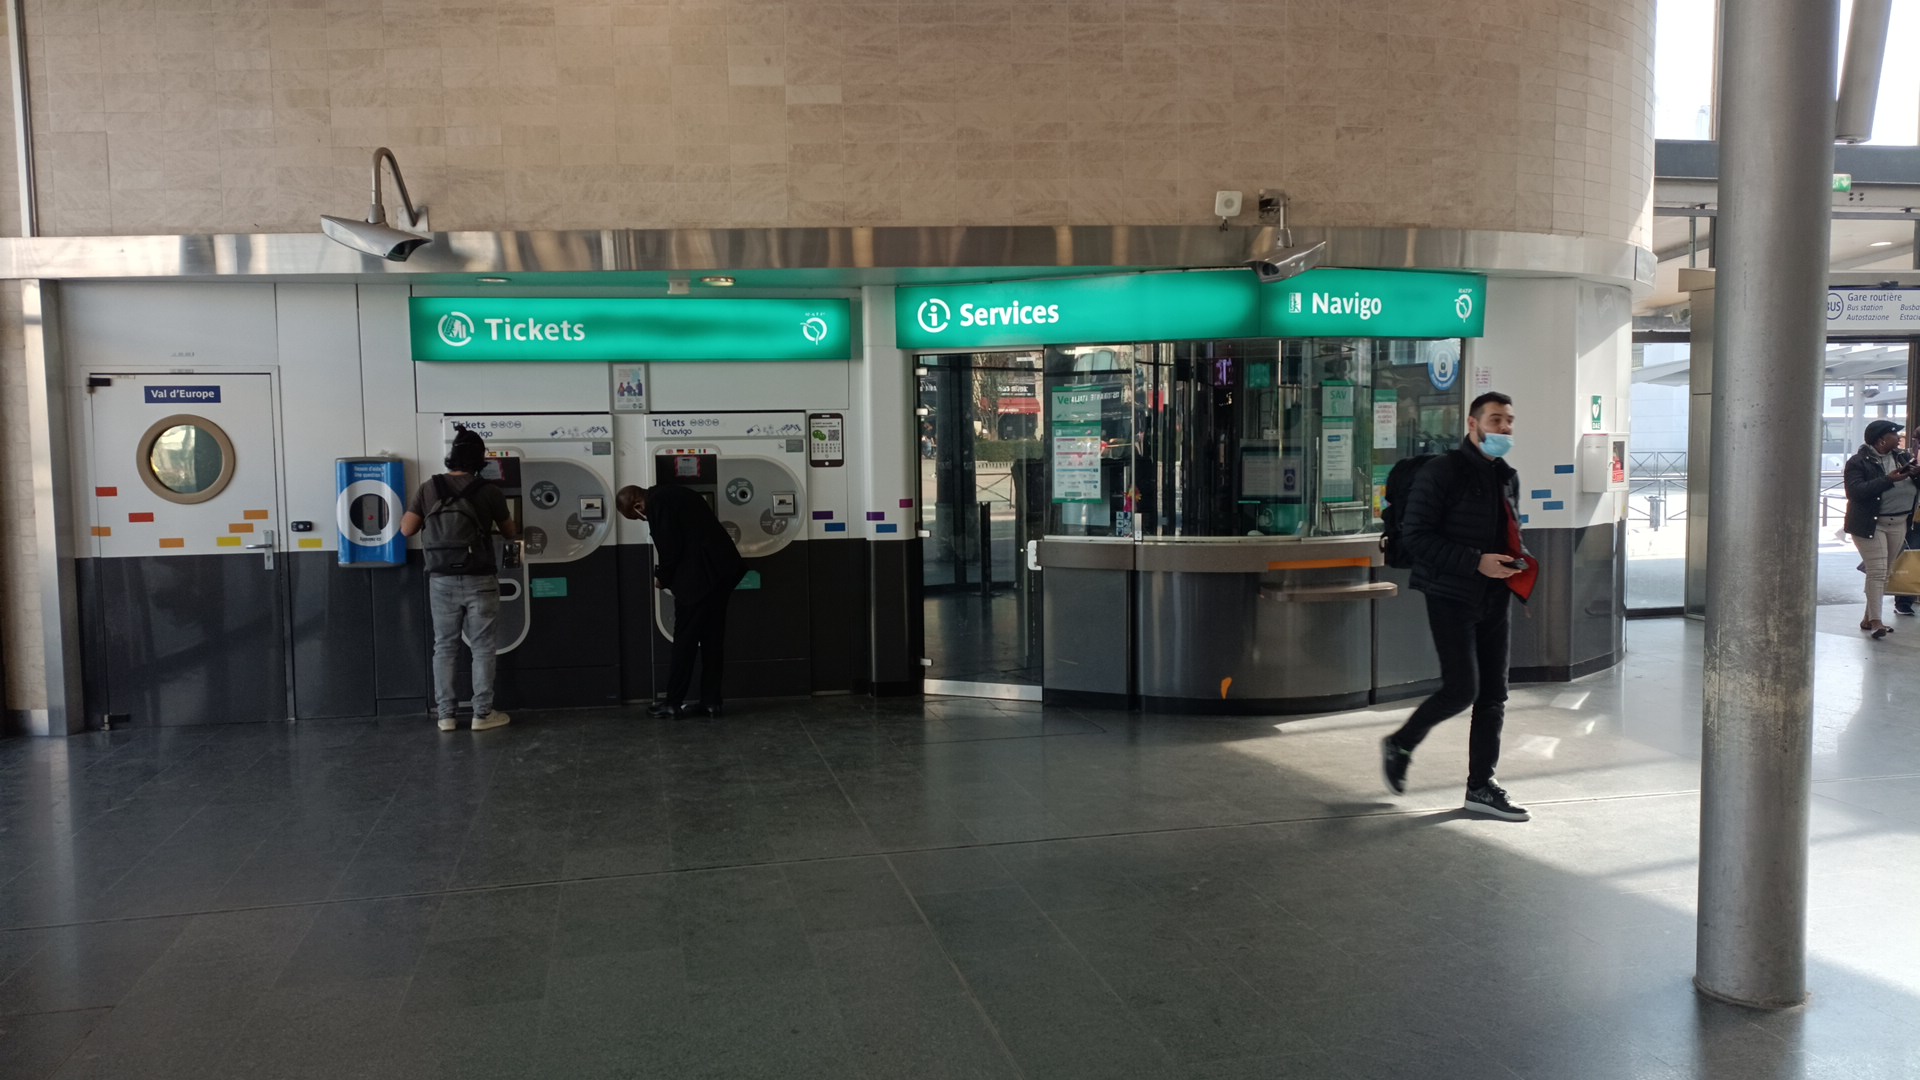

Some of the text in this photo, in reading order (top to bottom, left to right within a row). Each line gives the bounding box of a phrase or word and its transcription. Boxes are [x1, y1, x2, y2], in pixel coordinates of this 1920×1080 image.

[1847, 292, 1903, 302] Gare routière
[1312, 291, 1382, 320] Navigo
[959, 300, 1060, 327] Services
[1846, 313, 1890, 321] Autostazione
[484, 317, 586, 341] Tickets
[151, 389, 215, 400] Val d'Europe
[1330, 390, 1347, 400] SAV
[652, 418, 685, 427] Tickets
[663, 428, 692, 437] navigo
